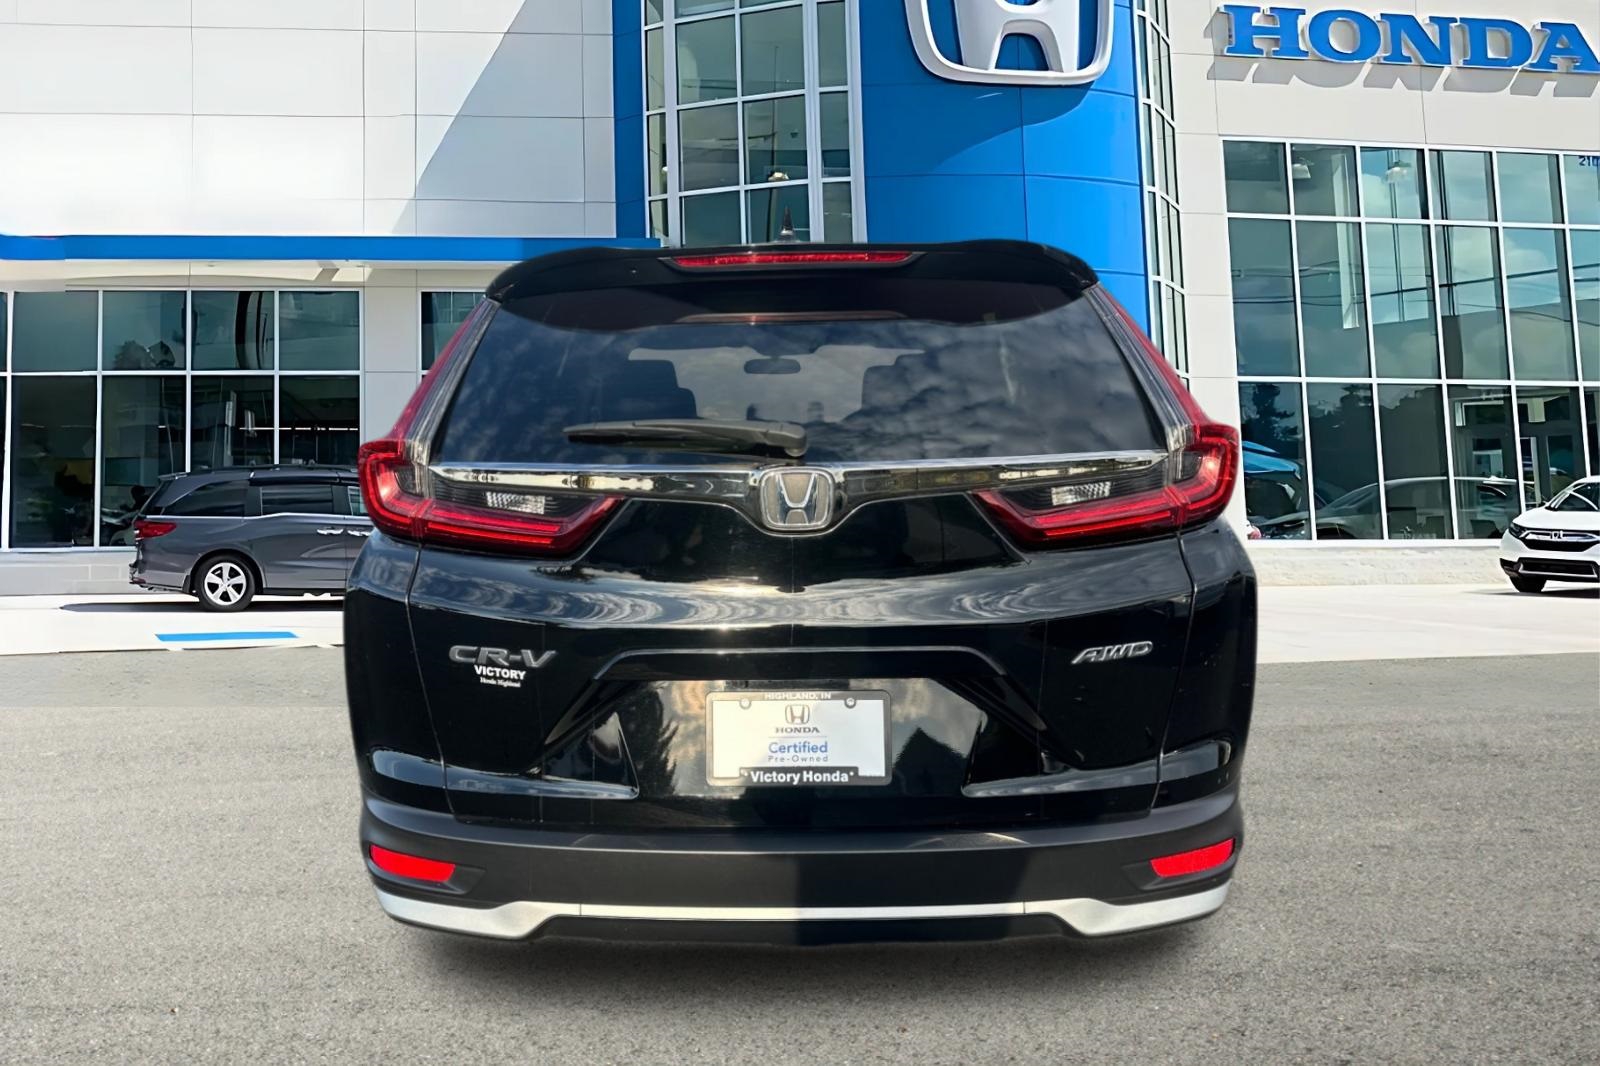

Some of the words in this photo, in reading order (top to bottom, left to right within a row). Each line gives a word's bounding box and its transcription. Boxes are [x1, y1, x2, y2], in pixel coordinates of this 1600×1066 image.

[1223, 4, 1600, 73] HONDA
[448, 644, 557, 668] CR-V
[1071, 640, 1153, 664] AWD
[473, 664, 527, 681] VICTORY
[775, 726, 820, 734] HONDA
[768, 741, 828, 753] Certified
[767, 754, 829, 763] Pre-Owned
[750, 770, 801, 785] Victory
[802, 770, 849, 783] Honda
